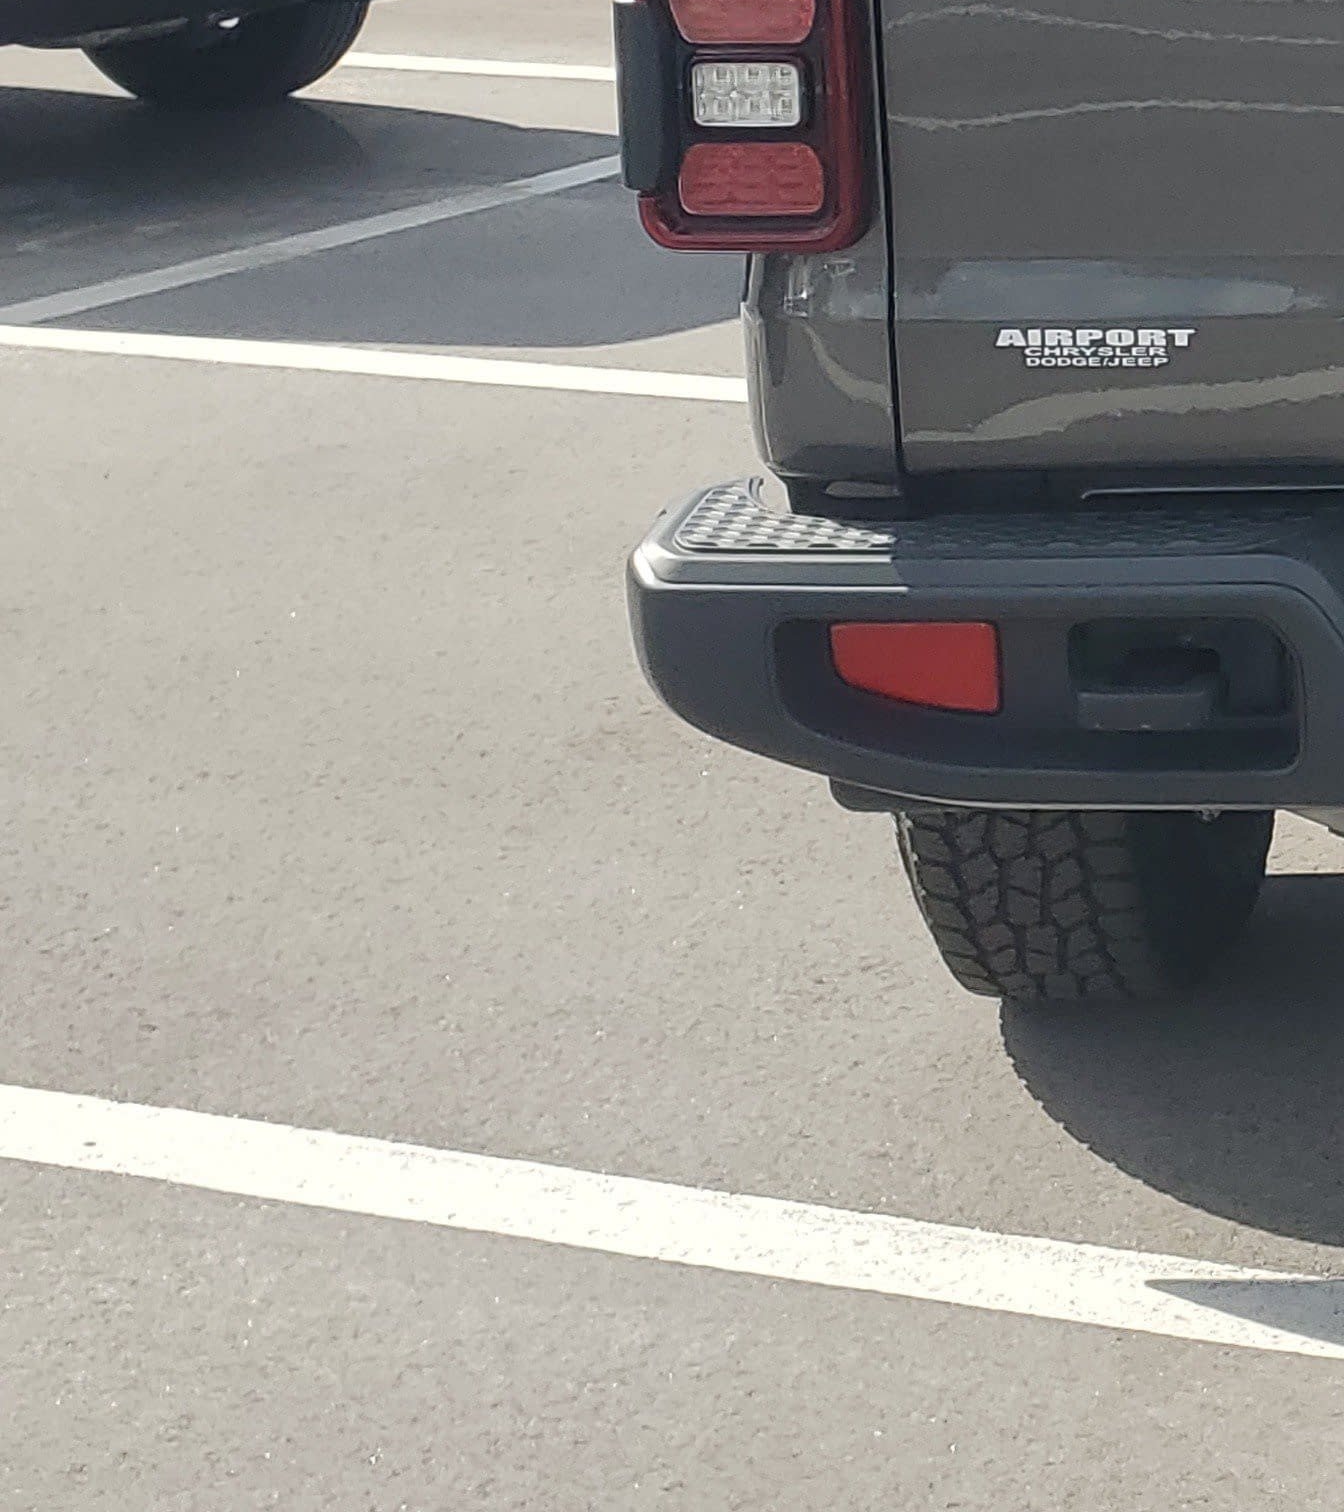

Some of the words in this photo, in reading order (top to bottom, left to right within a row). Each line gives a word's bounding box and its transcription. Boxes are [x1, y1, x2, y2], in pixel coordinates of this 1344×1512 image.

[995, 328, 1196, 347] AIRPORT
[1023, 346, 1168, 356] CHRYSLER
[1025, 357, 1169, 367] DODGE/JEEP
